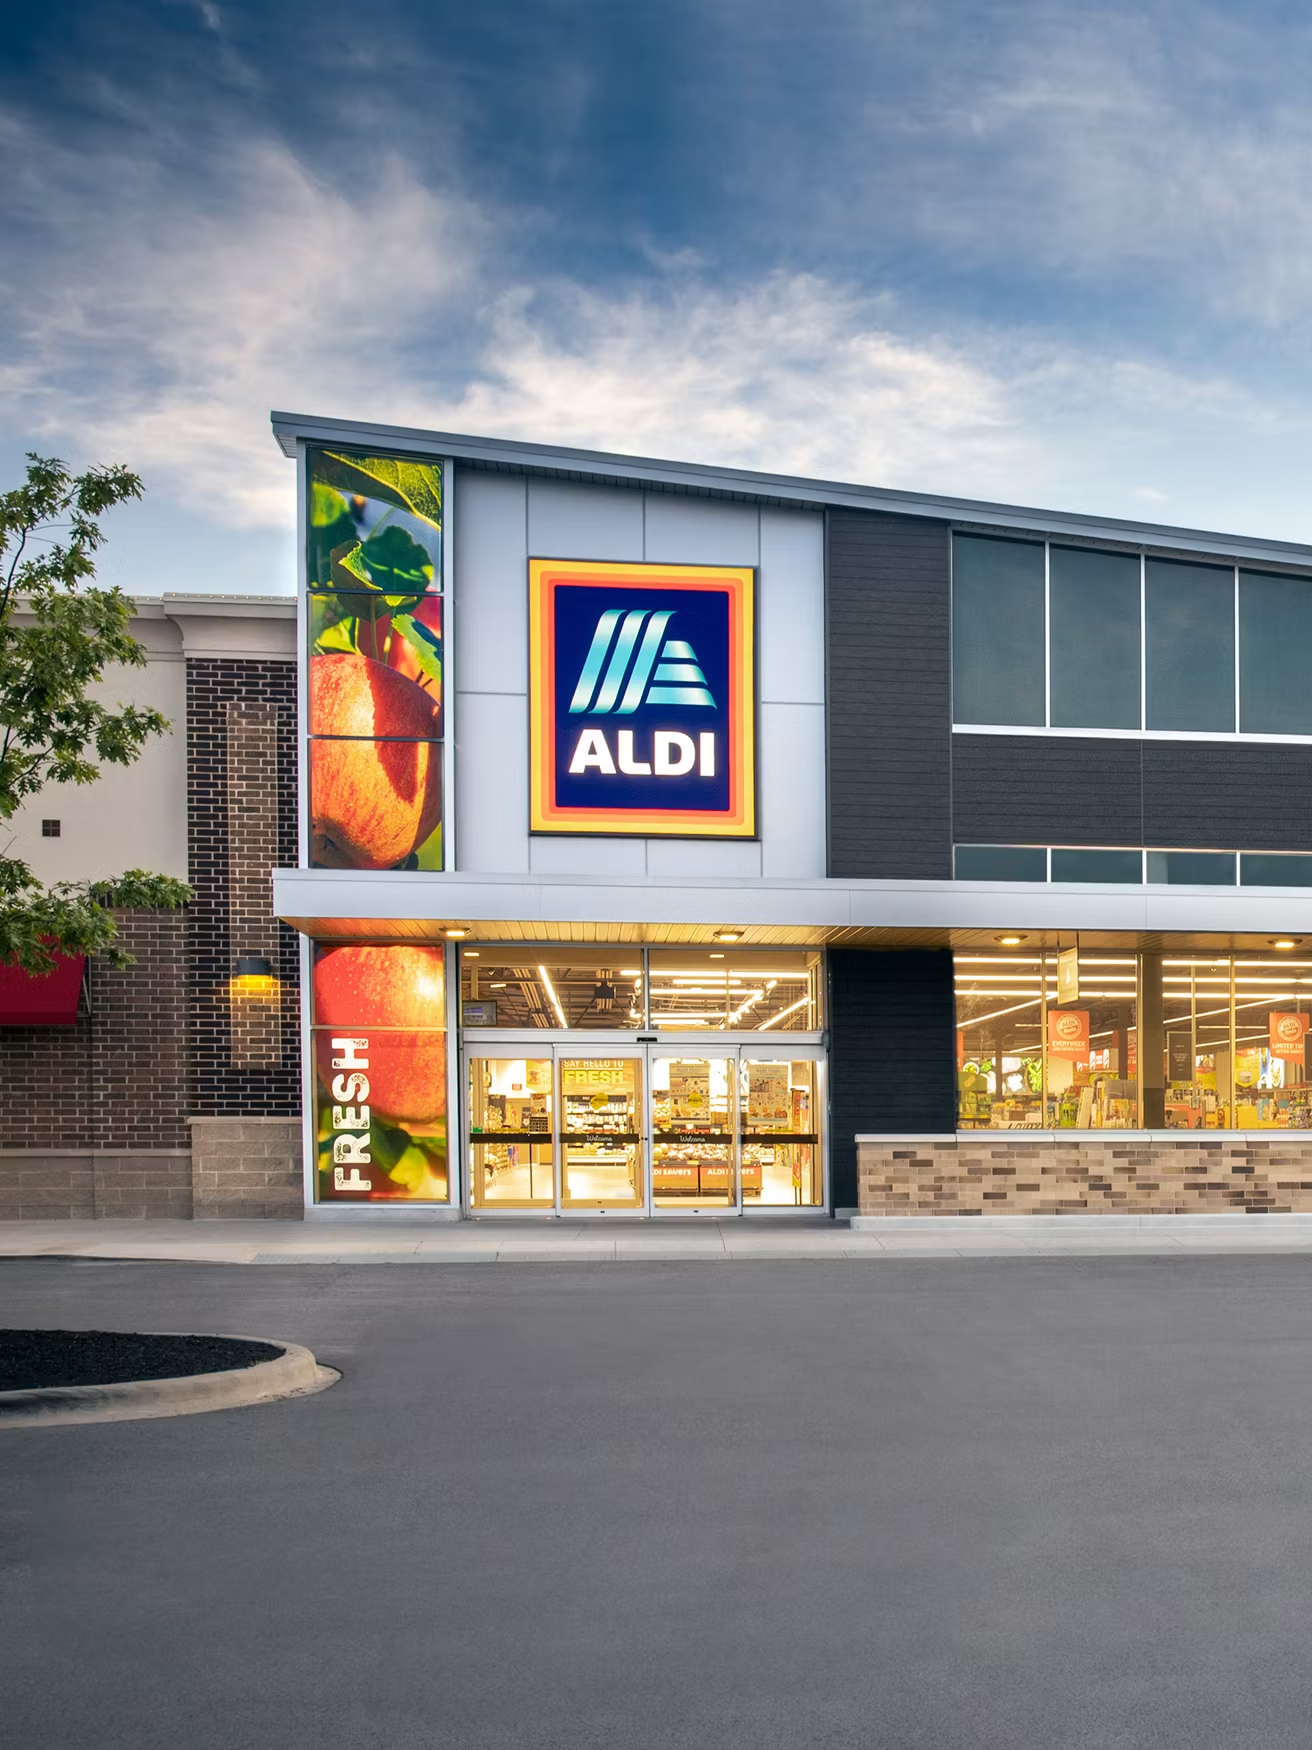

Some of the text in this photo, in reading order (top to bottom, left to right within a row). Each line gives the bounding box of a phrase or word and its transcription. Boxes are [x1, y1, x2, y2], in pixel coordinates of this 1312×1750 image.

[568, 729, 715, 777] ALDI
[564, 1060, 580, 1068] SAY
[583, 1060, 610, 1068] HELLO
[563, 1070, 624, 1084] FRESH
[331, 1038, 372, 1191] FRESH
[680, 1135, 706, 1143] Welcome
